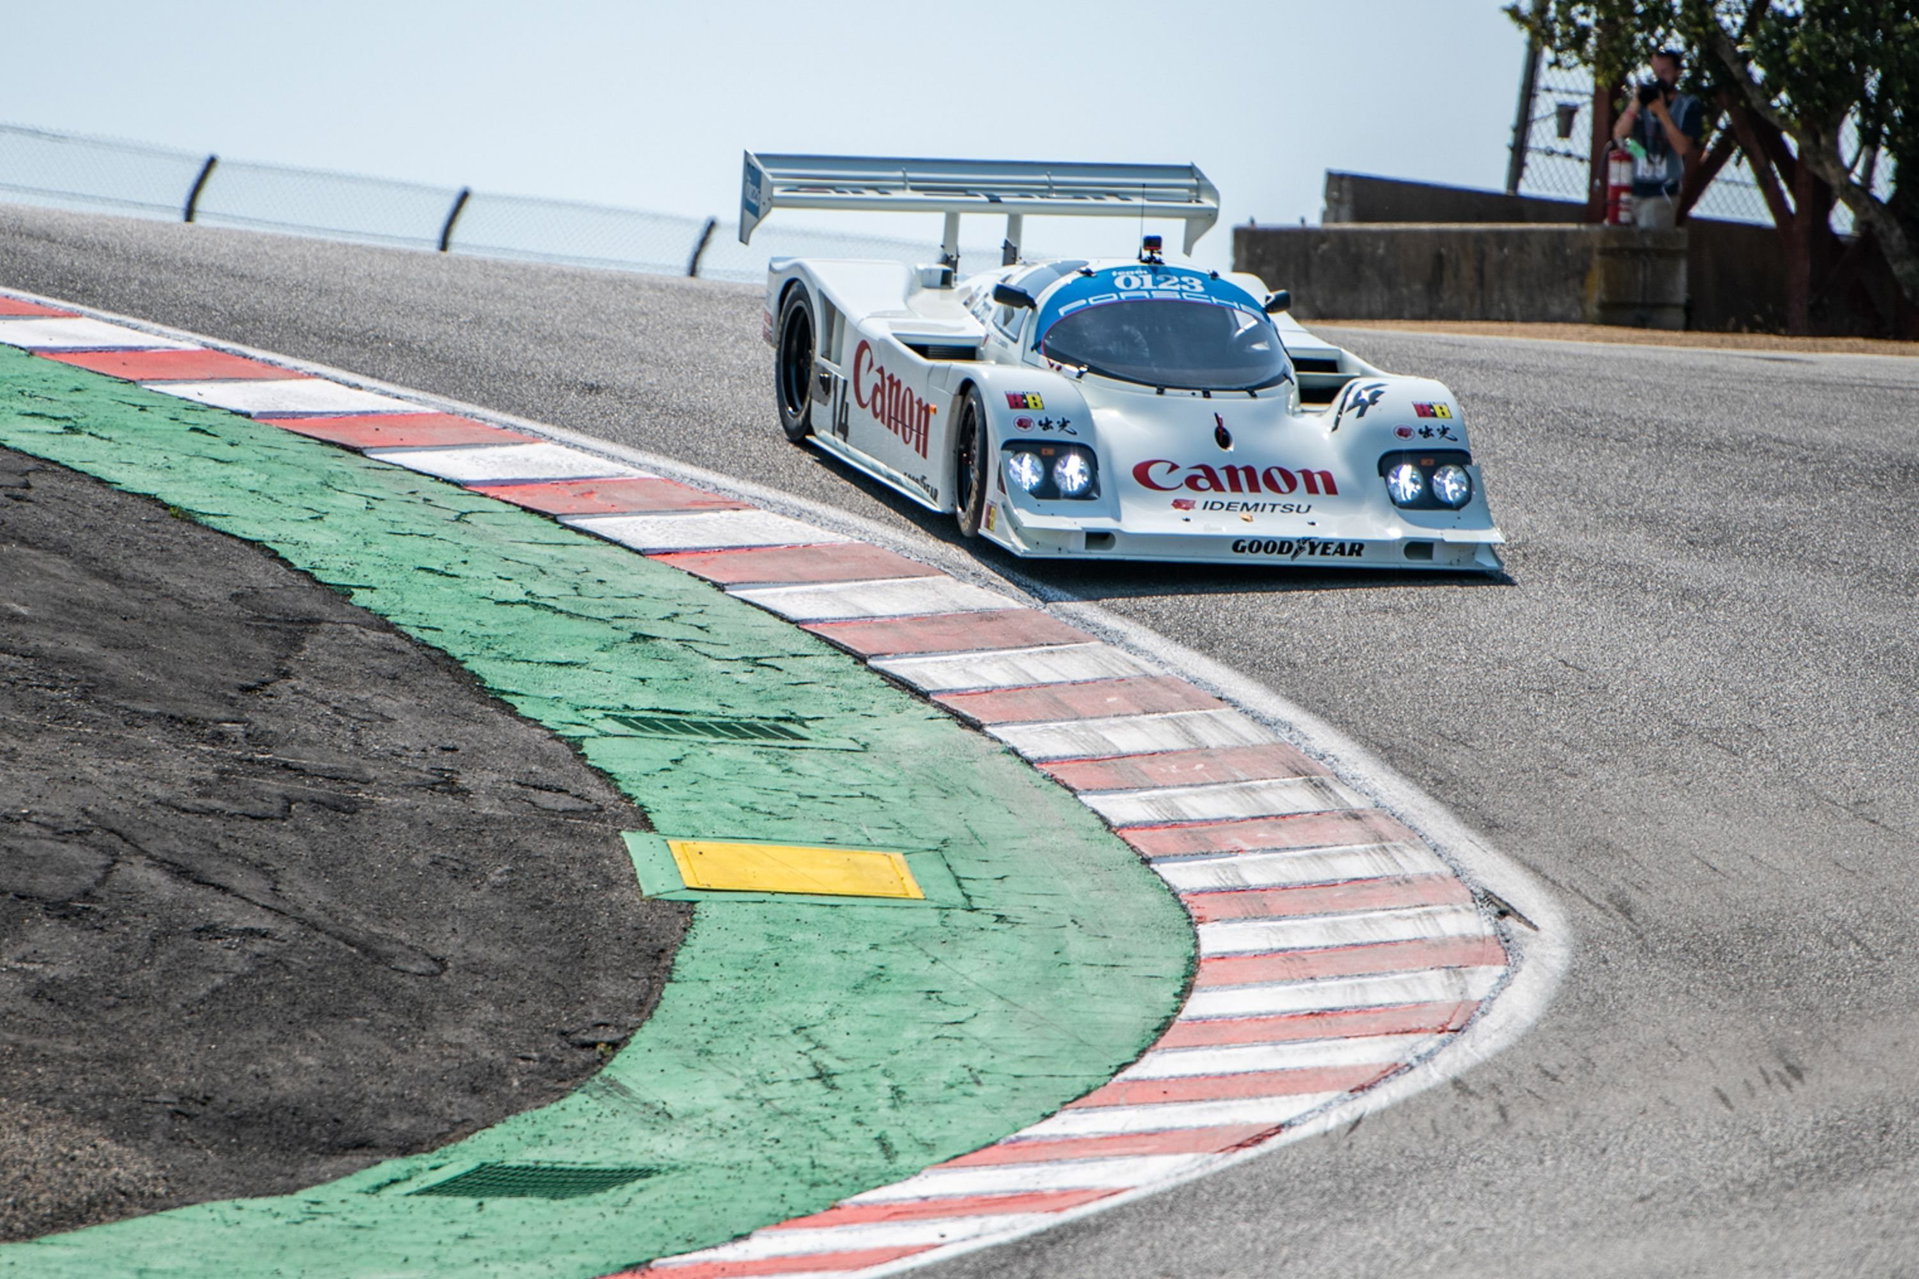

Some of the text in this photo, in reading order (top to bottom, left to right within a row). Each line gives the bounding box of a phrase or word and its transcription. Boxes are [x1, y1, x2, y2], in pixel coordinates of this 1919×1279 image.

[1114, 274, 1205, 293] 0123
[832, 374, 849, 443] 14
[853, 339, 932, 460] Canon
[1038, 416, 1078, 436] 出光
[1417, 424, 1458, 442] 出光
[1132, 458, 1339, 496] Canon
[1202, 500, 1312, 515] IDEMITSU
